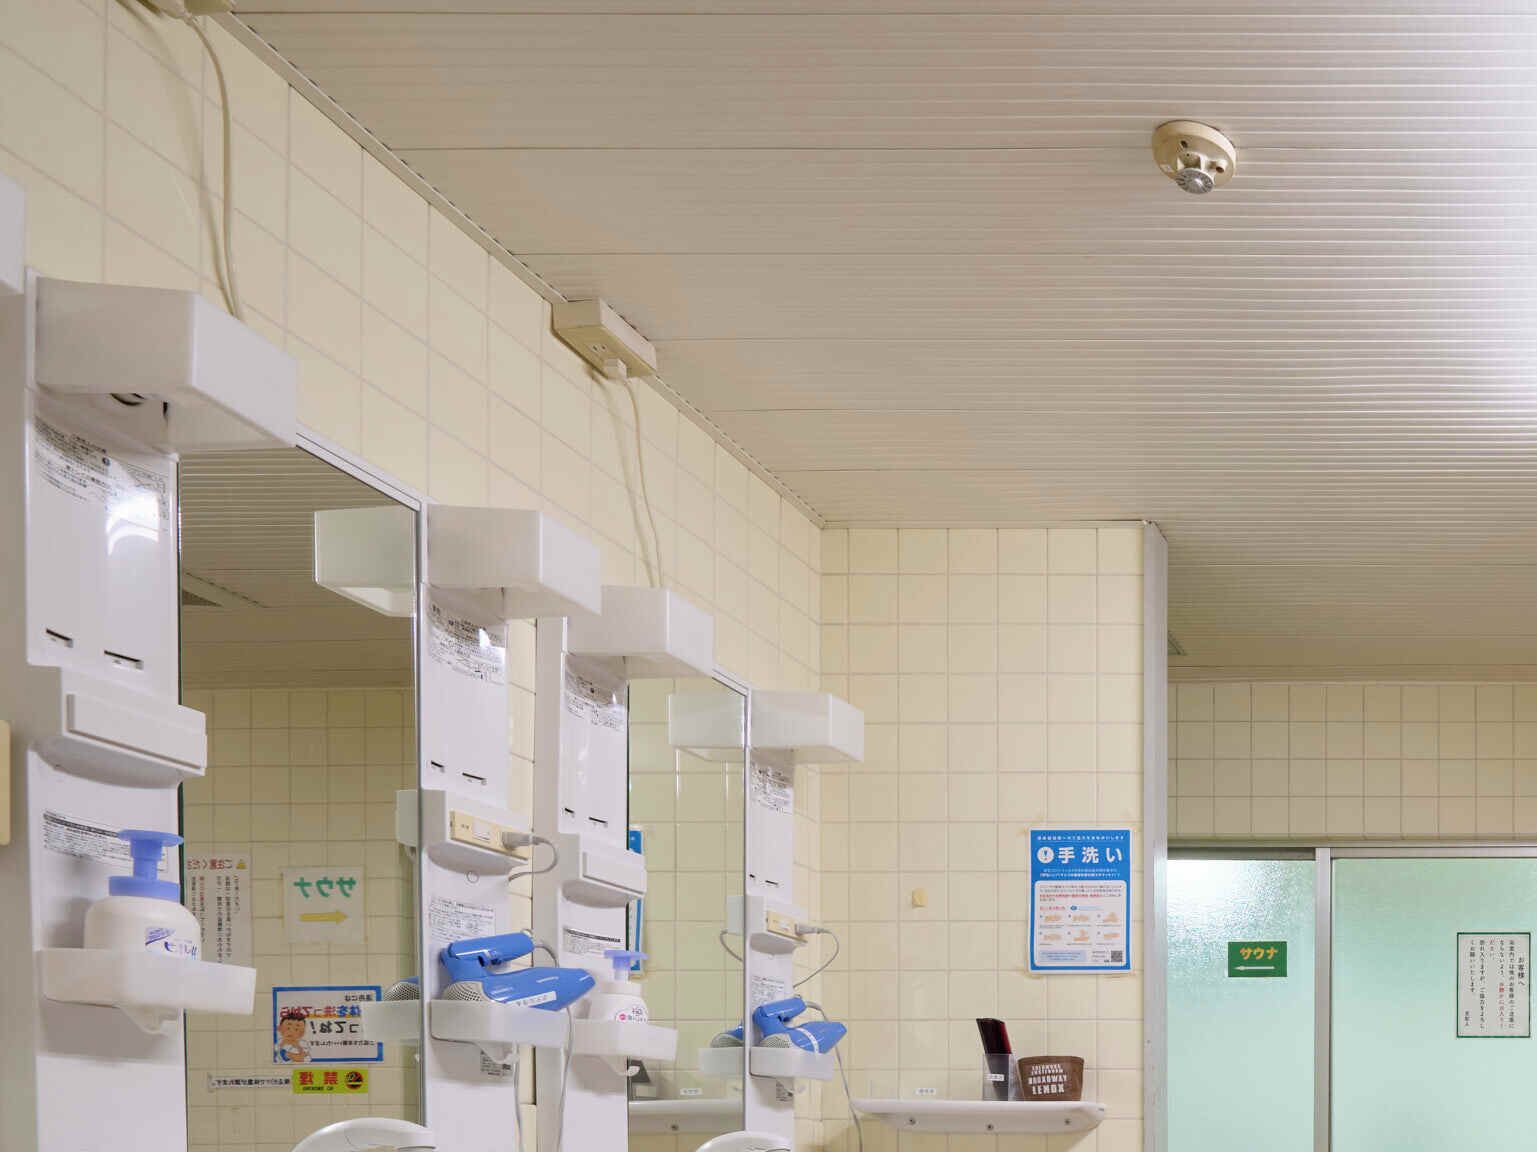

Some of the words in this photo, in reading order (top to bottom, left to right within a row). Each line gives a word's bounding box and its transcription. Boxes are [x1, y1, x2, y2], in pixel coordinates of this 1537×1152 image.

[1058, 846, 1123, 864] 手洗い
[1239, 946, 1279, 960] サウナ
